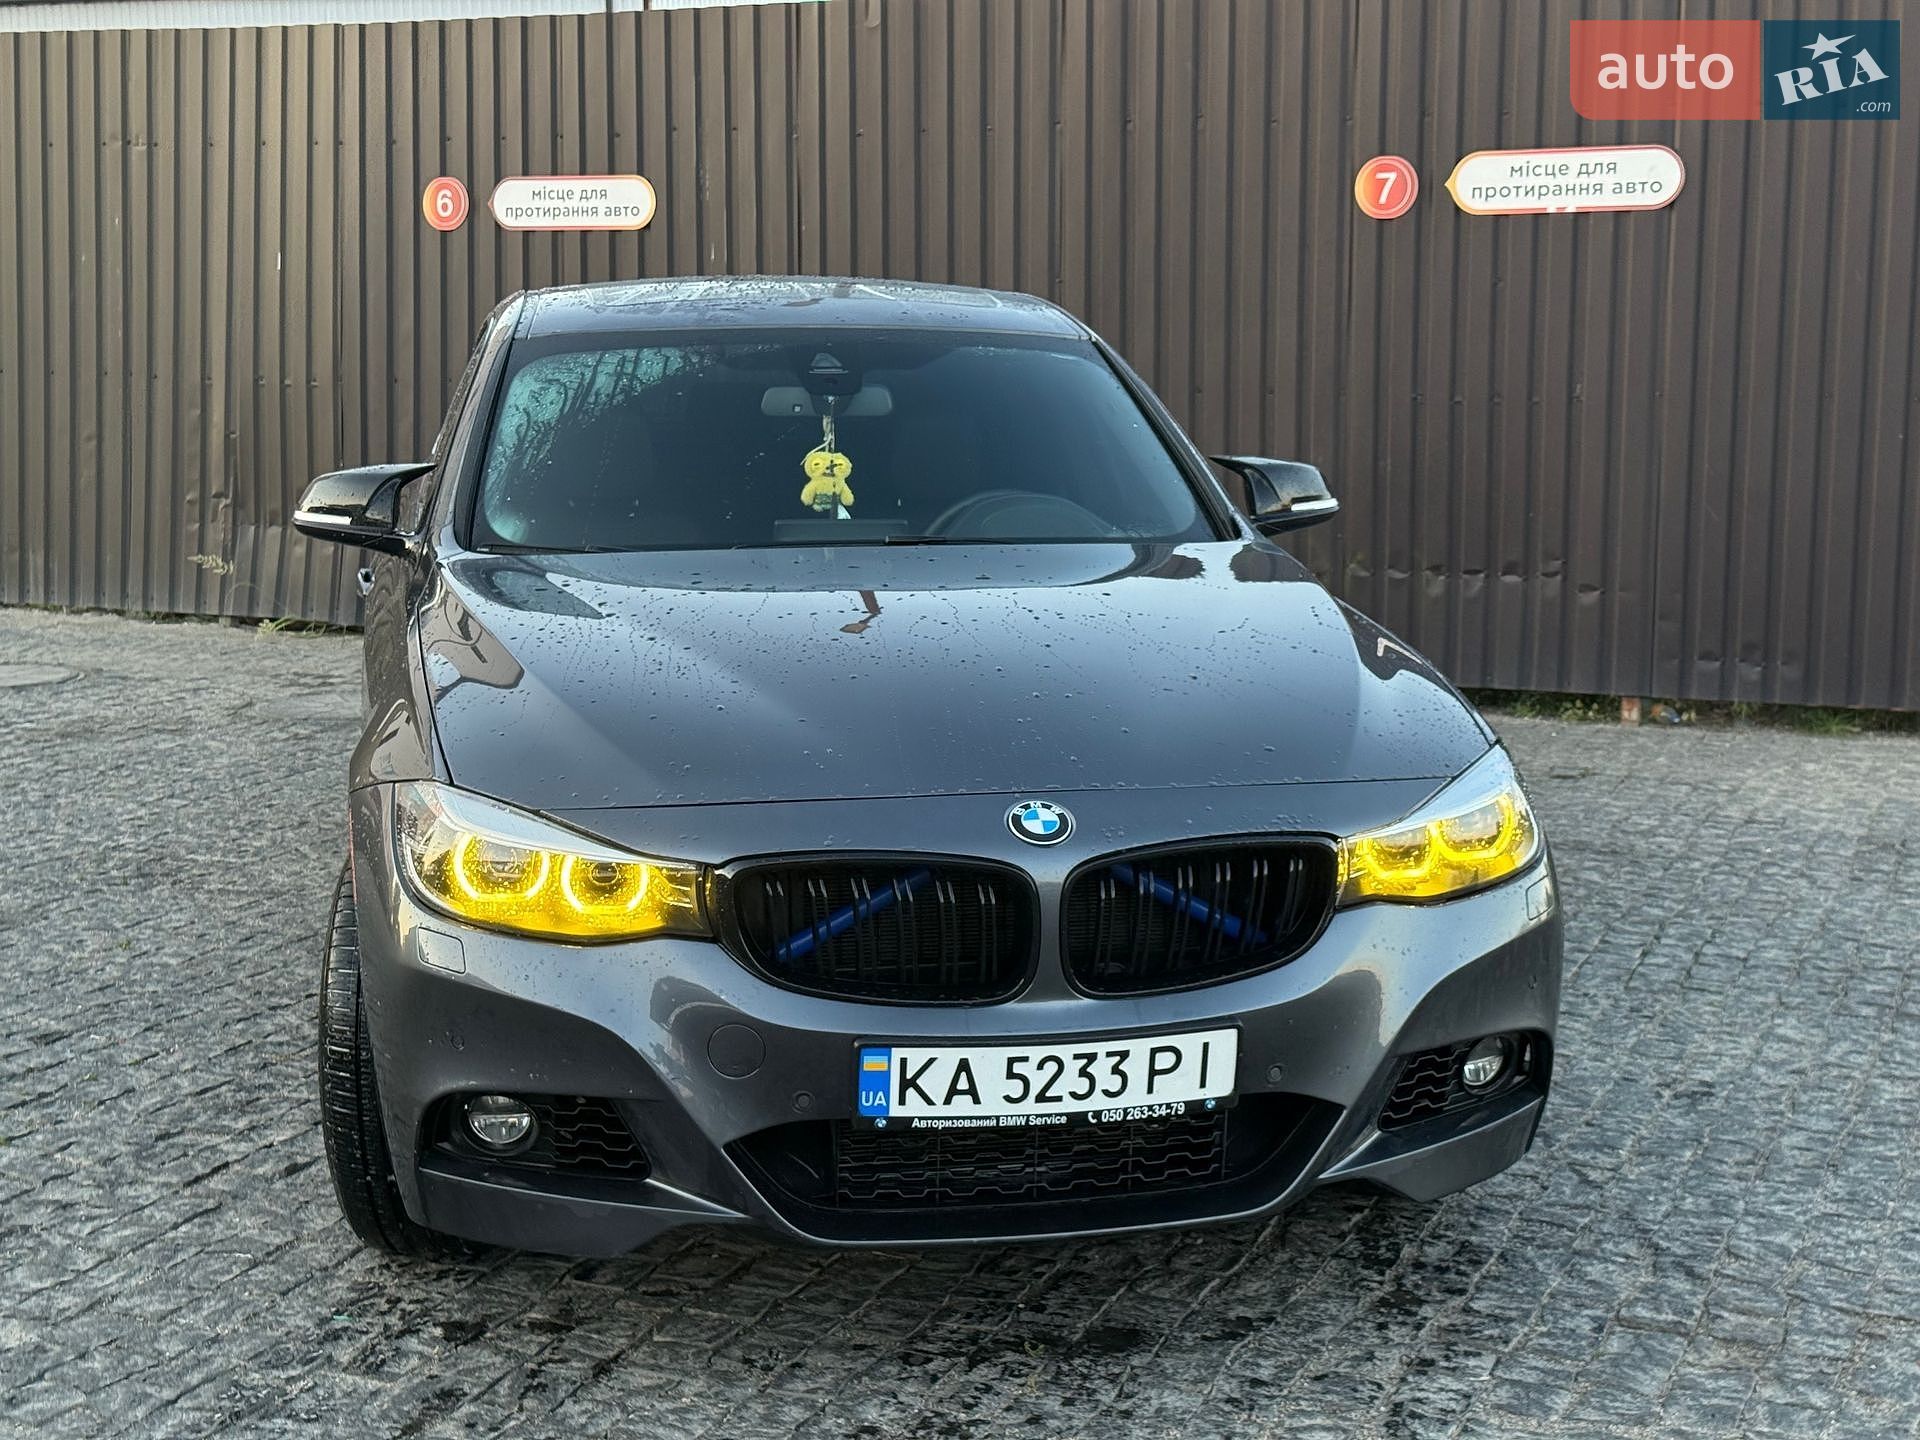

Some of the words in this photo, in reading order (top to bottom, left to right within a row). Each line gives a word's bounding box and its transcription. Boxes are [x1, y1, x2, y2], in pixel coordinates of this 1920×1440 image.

[1510, 161, 1570, 179] місце
[1577, 161, 1617, 177] для
[531, 185, 575, 202] місце
[579, 188, 608, 202] для
[1374, 171, 1398, 205] 7
[1471, 182, 1604, 202] протирання
[1611, 180, 1663, 194] авто
[436, 189, 454, 218] 6
[505, 205, 599, 221] протирання
[604, 207, 640, 217] авто
[1002, 1049, 1131, 1104] 5233
[861, 1091, 887, 1107] UA
[911, 1117, 997, 1130] Авторизований
[999, 1116, 1026, 1127] BMW
[1028, 1114, 1067, 1126] Service
[1101, 1109, 1124, 1123] 050
[1126, 1102, 1186, 1120] 263-34-79
